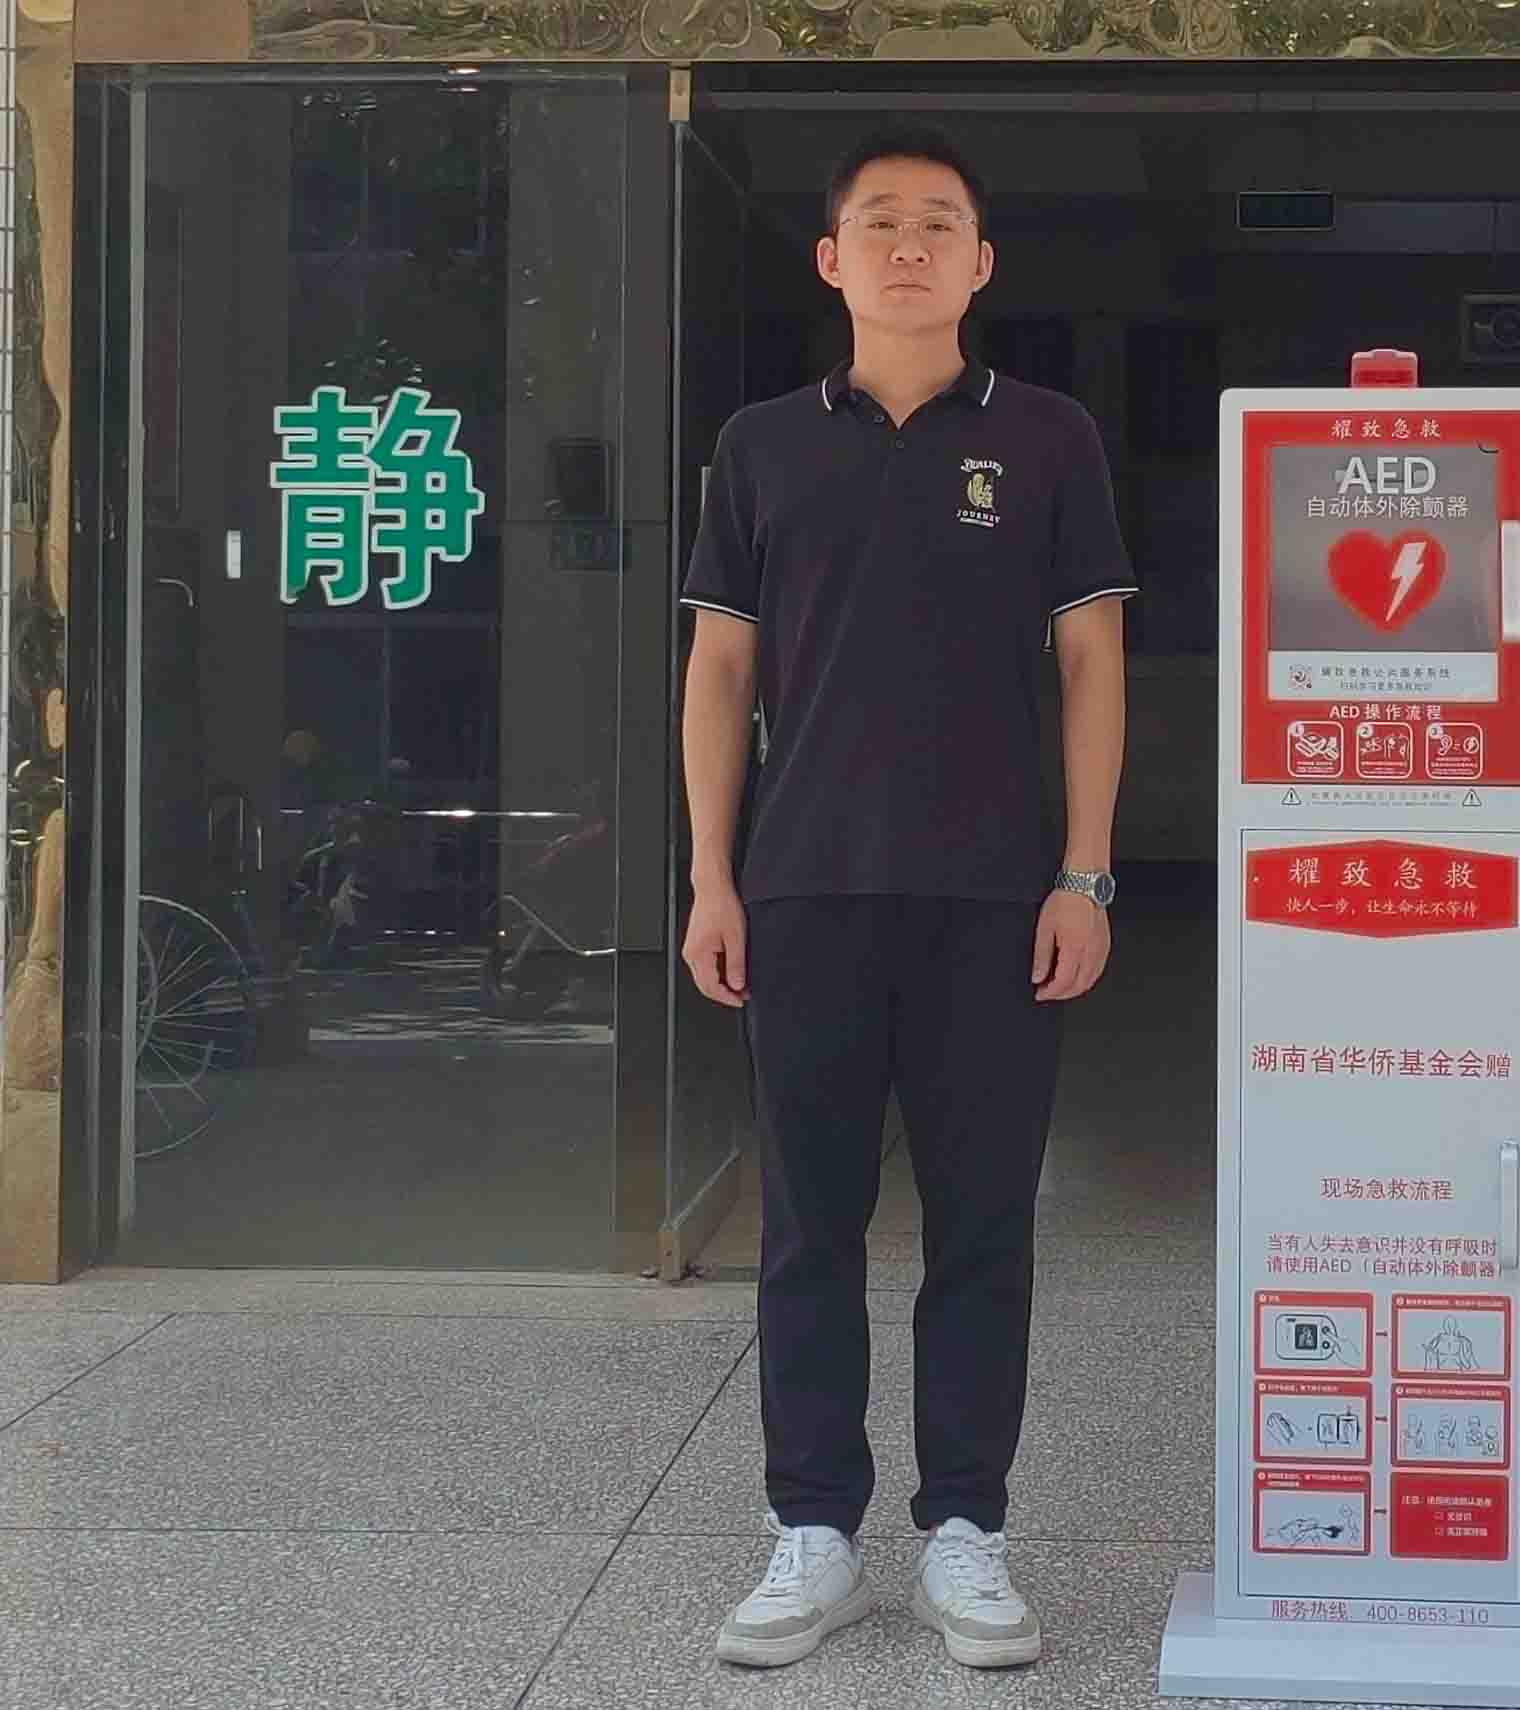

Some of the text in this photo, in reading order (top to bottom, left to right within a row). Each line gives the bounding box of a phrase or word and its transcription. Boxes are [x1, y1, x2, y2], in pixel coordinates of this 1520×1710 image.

[1331, 416, 1441, 440] 耀致急救
[1337, 456, 1437, 495] AED
[270, 385, 485, 610] 静
[1306, 496, 1470, 520] 自动体外除颤器
[1329, 704, 1442, 720] AED 操作流程
[1287, 857, 1480, 890] 耀致急救
[1251, 1044, 1512, 1079] 湖南省华侨基金会赠
[1319, 1177, 1456, 1201] 现场急救流程
[1267, 1234, 1498, 1257] 当有人失去意识并没有呼吸时
[1271, 1599, 1490, 1625] 服务热线 400-8653-110
